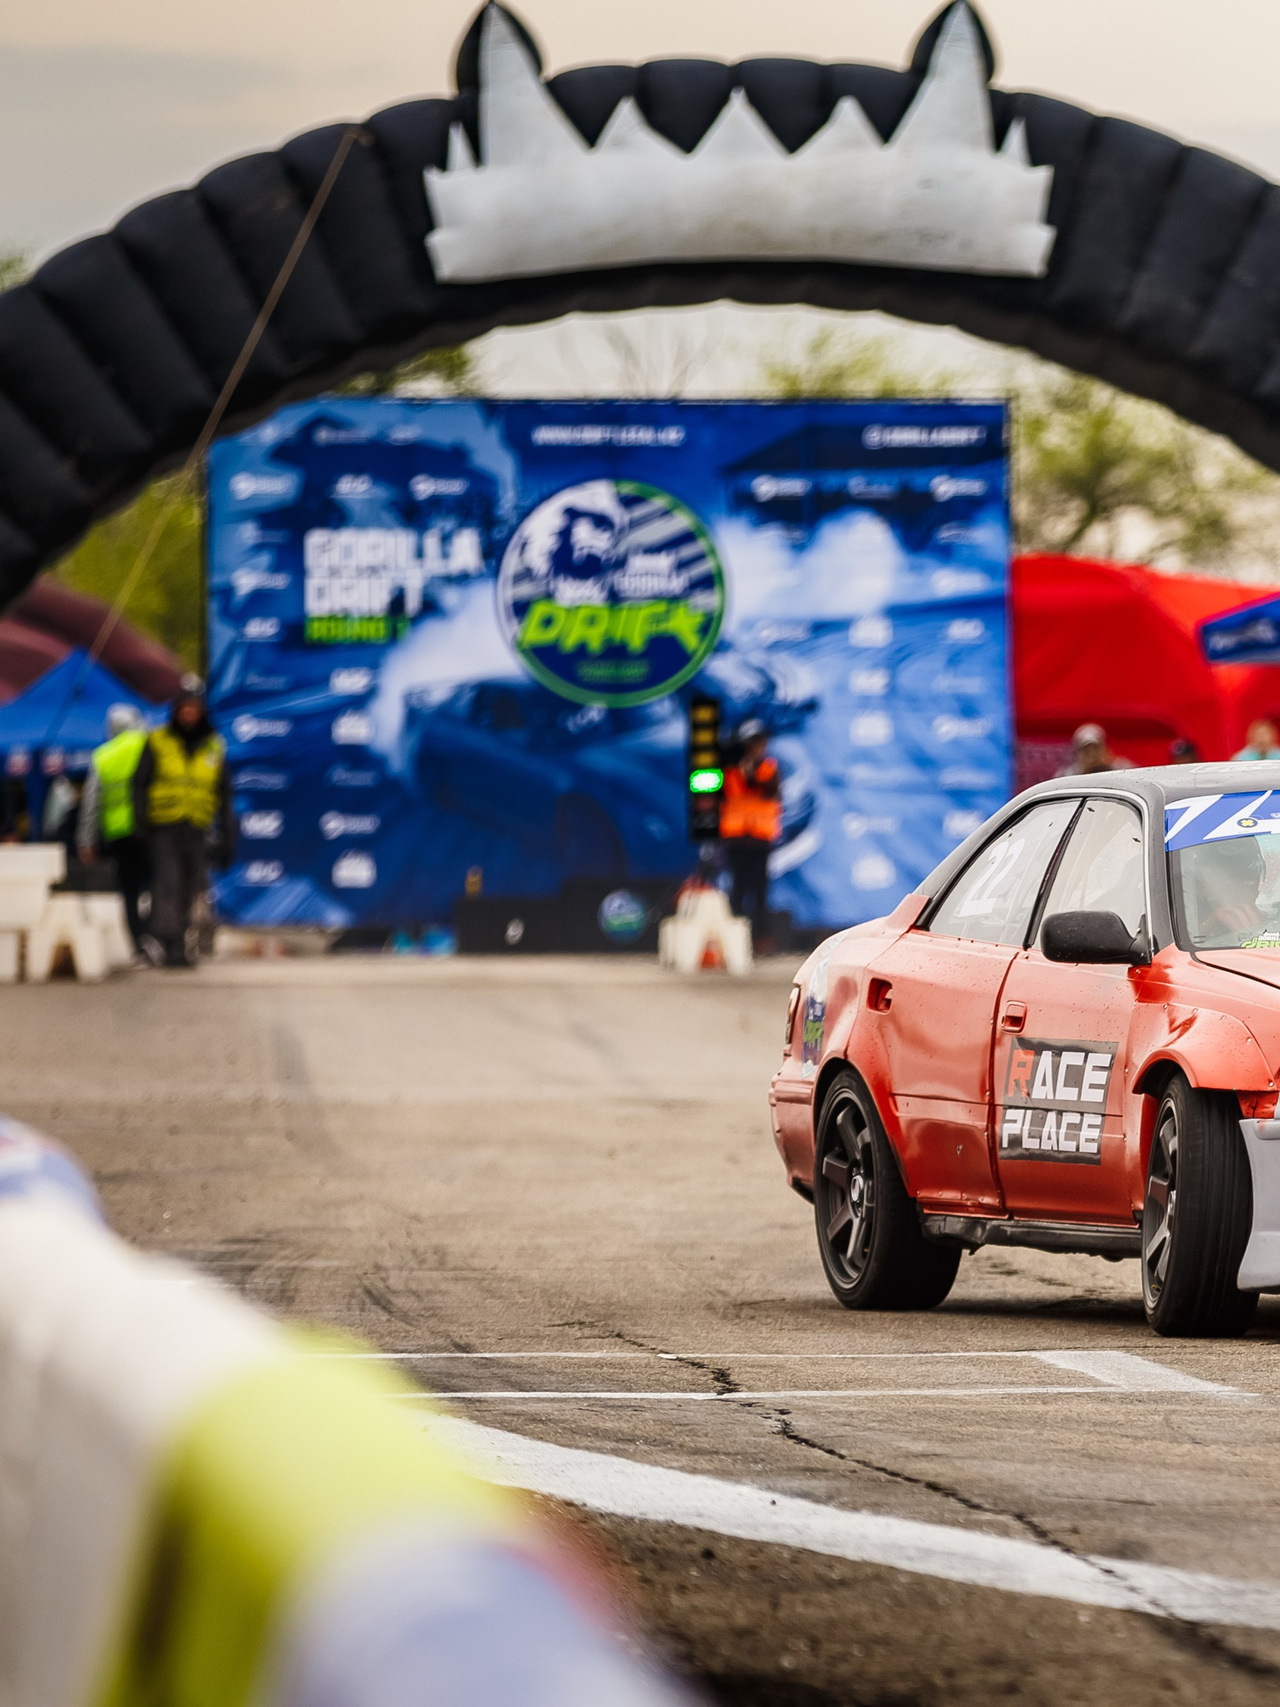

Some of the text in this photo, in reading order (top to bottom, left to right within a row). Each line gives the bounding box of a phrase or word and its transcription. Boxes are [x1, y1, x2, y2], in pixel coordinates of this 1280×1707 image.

[305, 528, 485, 575] GORILLA
[305, 577, 423, 617] DRIFT
[521, 600, 706, 655] DRIFT
[958, 838, 1025, 918] 22
[1007, 1049, 1113, 1103] RACE
[1001, 1108, 1102, 1154] PLACE
